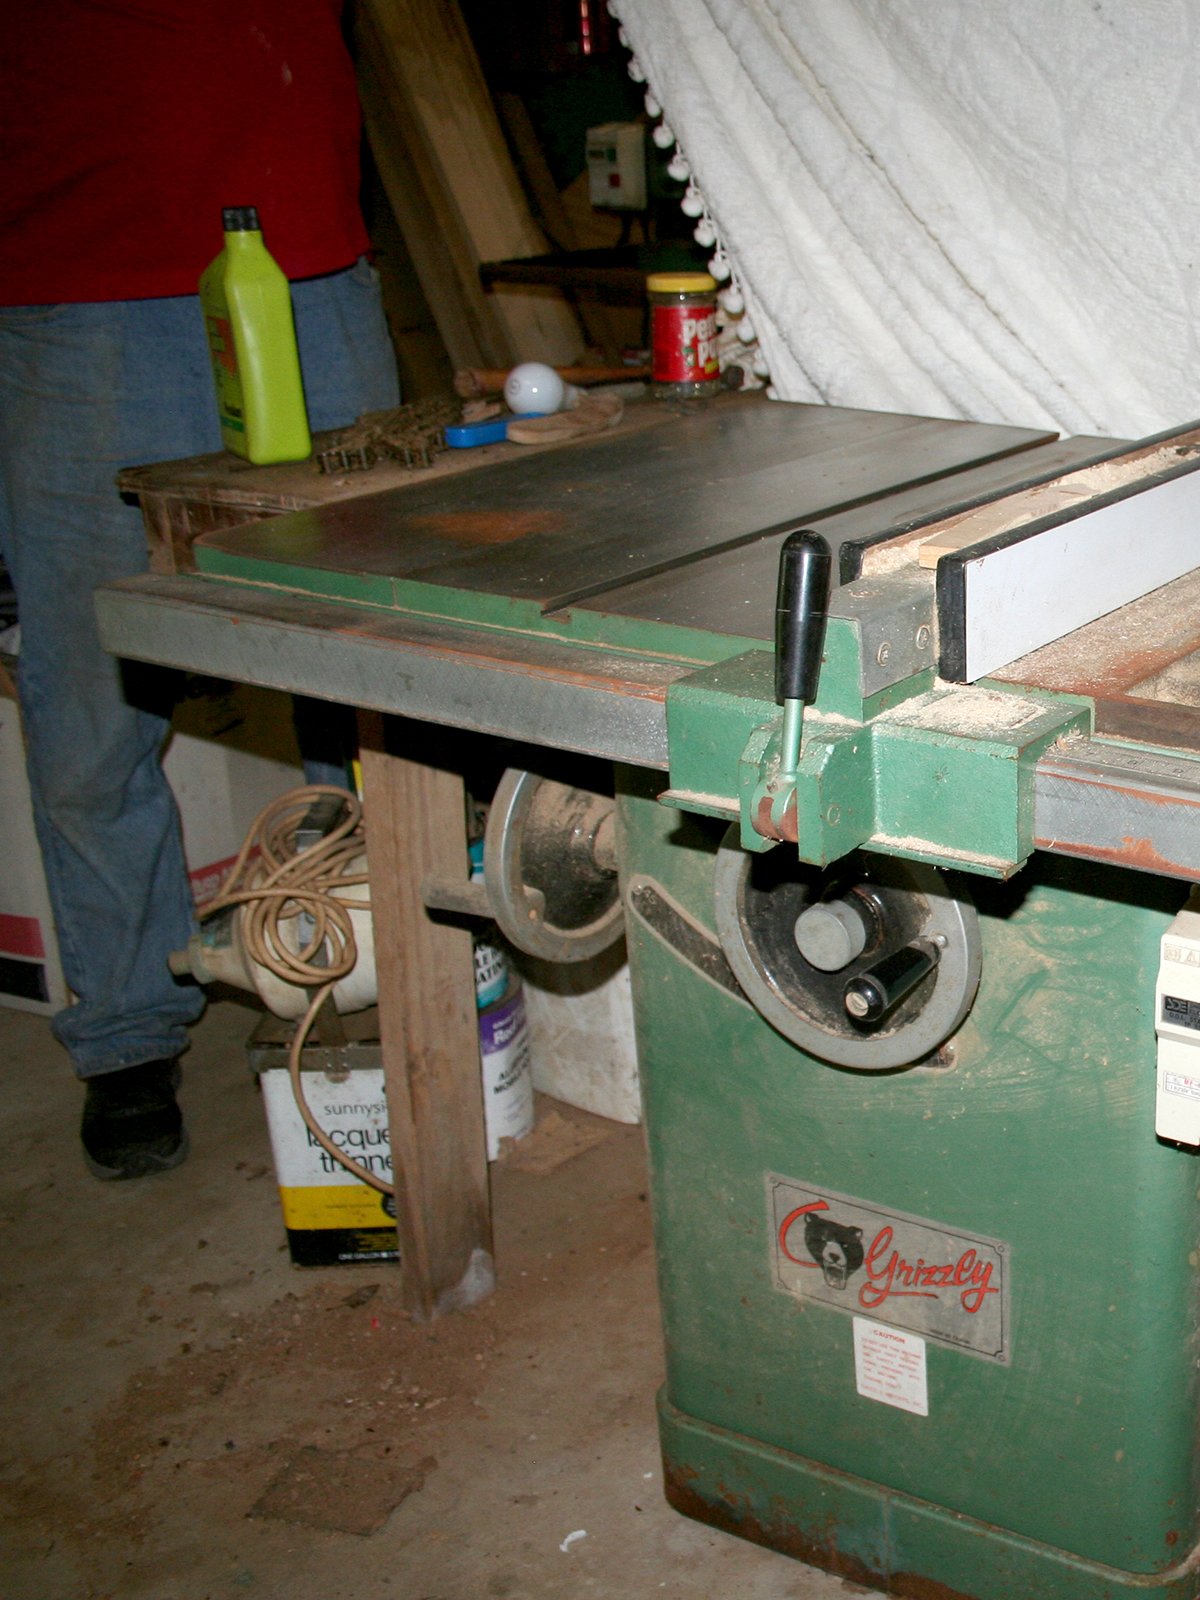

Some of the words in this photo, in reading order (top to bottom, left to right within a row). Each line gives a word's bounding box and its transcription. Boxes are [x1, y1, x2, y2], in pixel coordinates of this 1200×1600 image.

[324, 1100, 387, 1118] sunnysi
[306, 1126, 391, 1150] lcque
[320, 1152, 393, 1173] thnne
[859, 1226, 999, 1313] Grizzly
[873, 1329, 906, 1345] CAUTION
